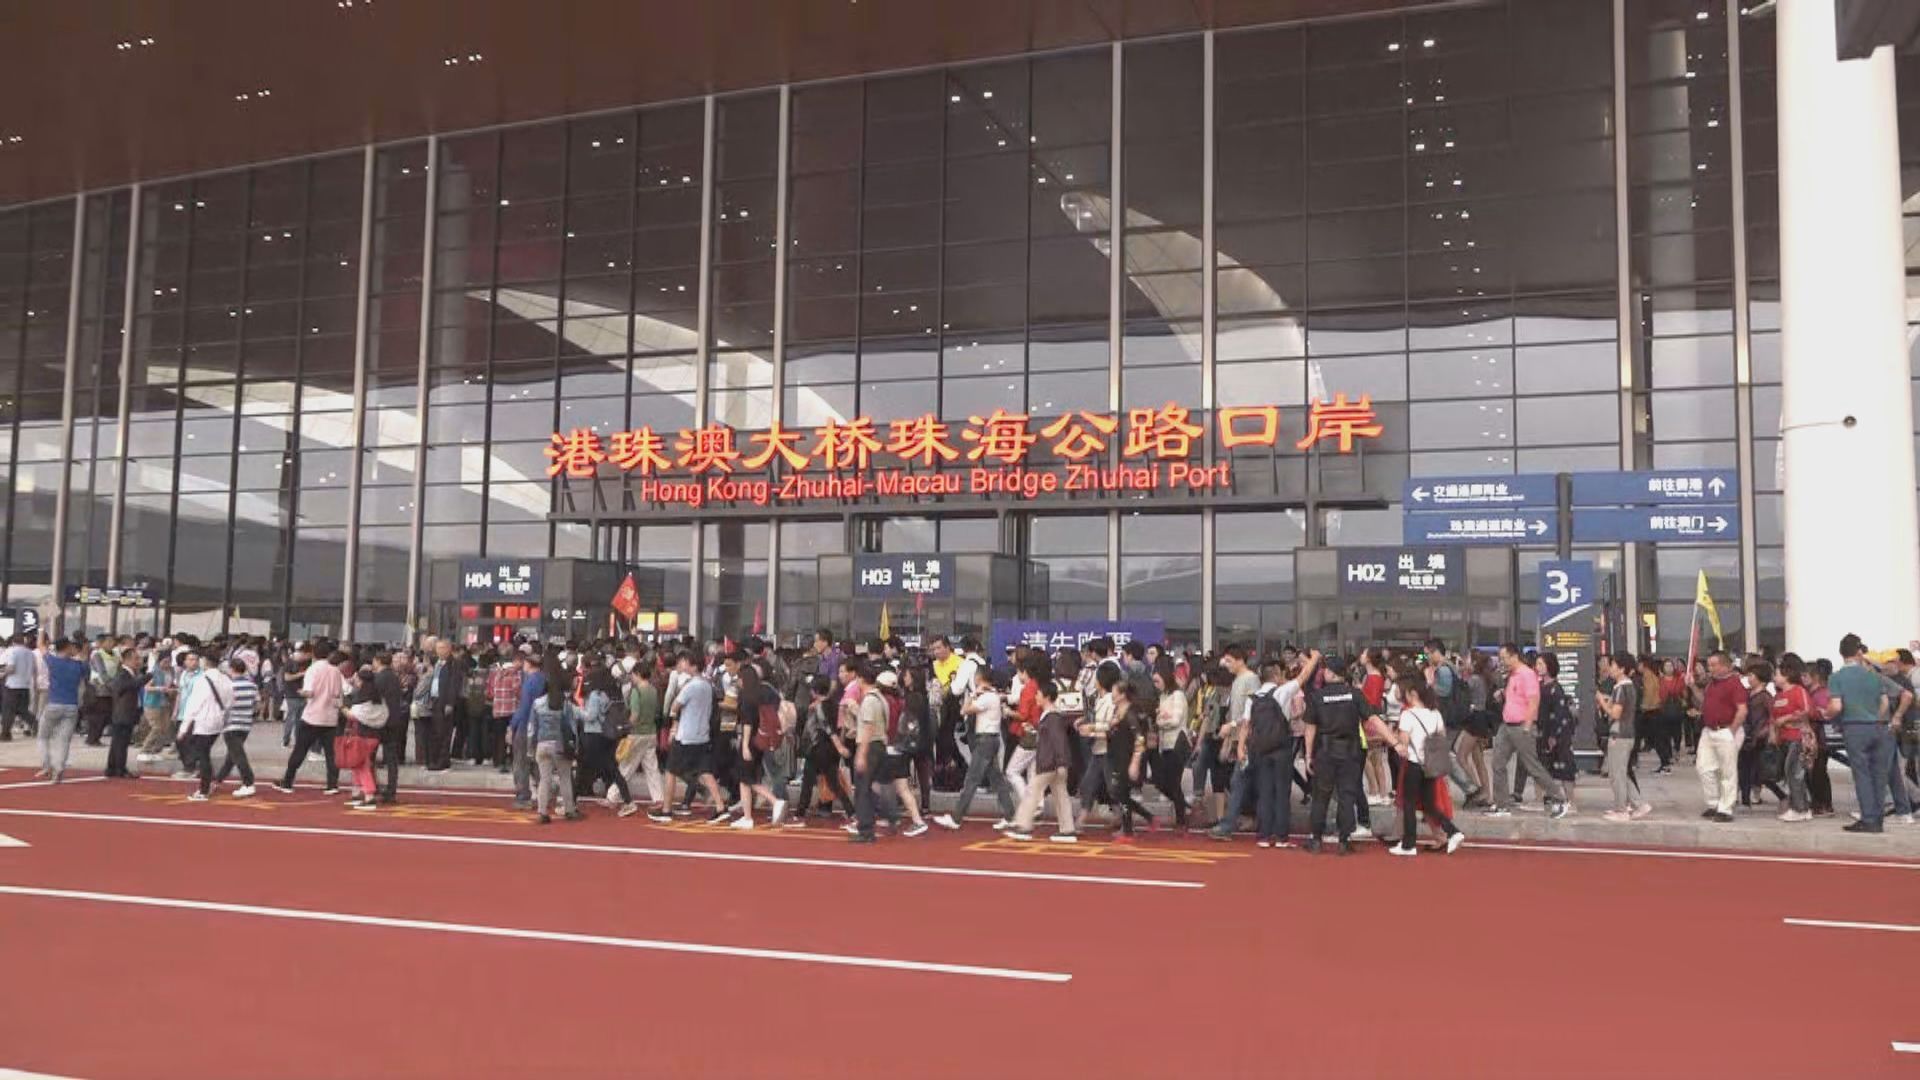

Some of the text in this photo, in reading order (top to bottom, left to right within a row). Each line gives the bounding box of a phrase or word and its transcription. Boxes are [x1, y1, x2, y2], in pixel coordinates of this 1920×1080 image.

[543, 393, 1383, 477] 港珠澳大桥珠海公路口岸
[641, 479, 702, 508] Hong
[970, 467, 1057, 498] Bridge
[1064, 463, 1159, 491] Zhuhai
[1168, 461, 1231, 489] Port
[465, 572, 492, 588] H04
[861, 568, 893, 586] H03
[1348, 563, 1386, 582] H02
